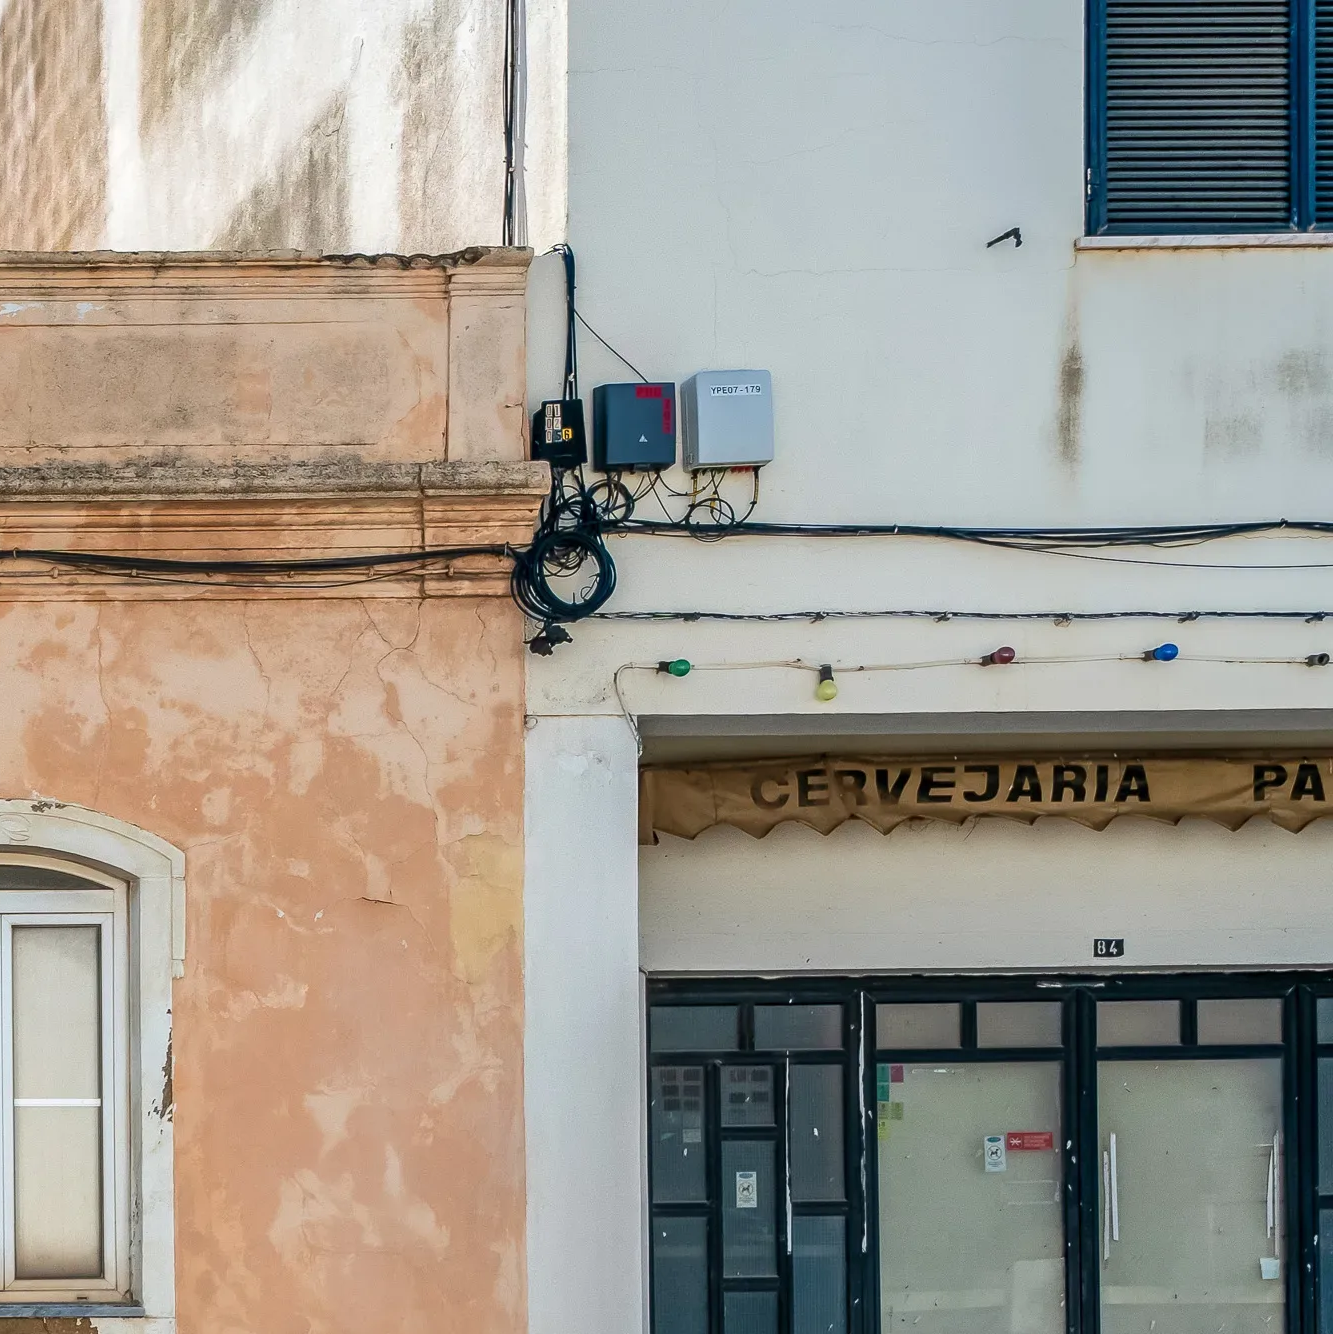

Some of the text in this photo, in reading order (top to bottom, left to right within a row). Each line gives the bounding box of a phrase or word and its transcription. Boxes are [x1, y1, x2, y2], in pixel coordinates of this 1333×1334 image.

[710, 385, 761, 395] YPE07-179
[750, 764, 1151, 810] CERVEJARIA
[1097, 940, 1118, 955] 84
